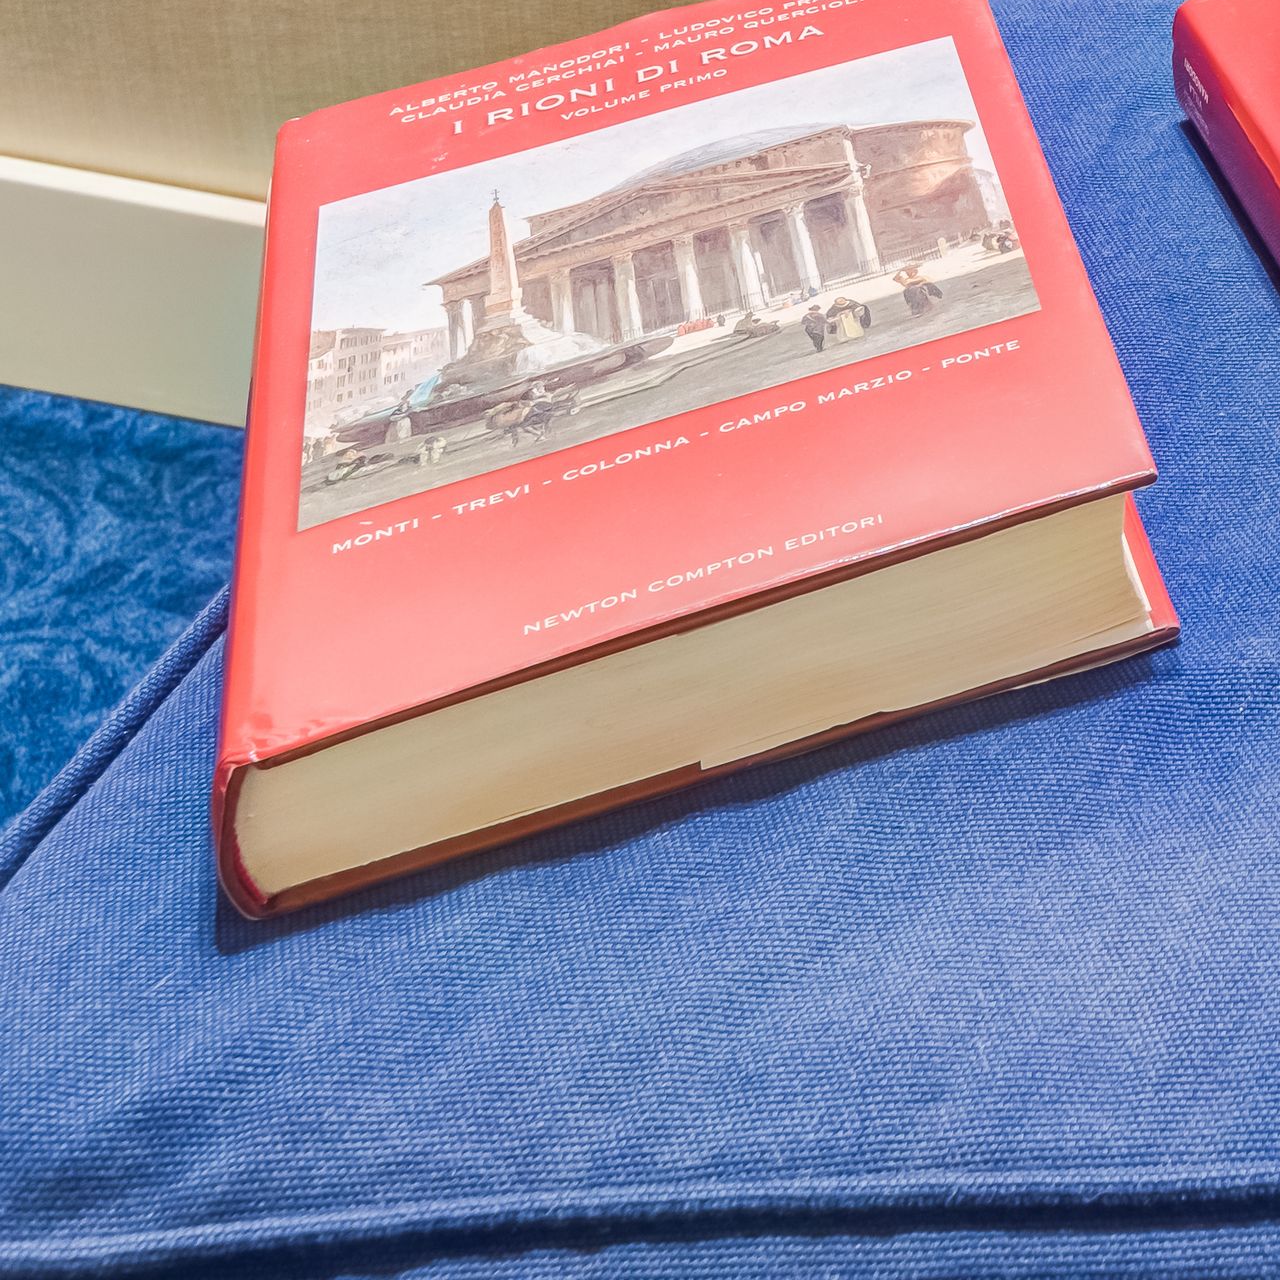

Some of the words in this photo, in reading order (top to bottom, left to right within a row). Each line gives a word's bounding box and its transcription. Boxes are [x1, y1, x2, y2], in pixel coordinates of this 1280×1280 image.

[453, 120, 464, 135] I
[487, 78, 615, 127] RIONI
[636, 59, 678, 84] DI
[700, 24, 825, 65] ROMA
[560, 89, 651, 121] VOLUME
[660, 68, 727, 91] PRIMO
[331, 517, 421, 555] MONTI
[453, 482, 532, 518] TREVI
[562, 434, 691, 483] COLONNA
[718, 399, 808, 435] CAMPO
[817, 368, 913, 406] MARZIO
[940, 339, 1021, 371] PONTE
